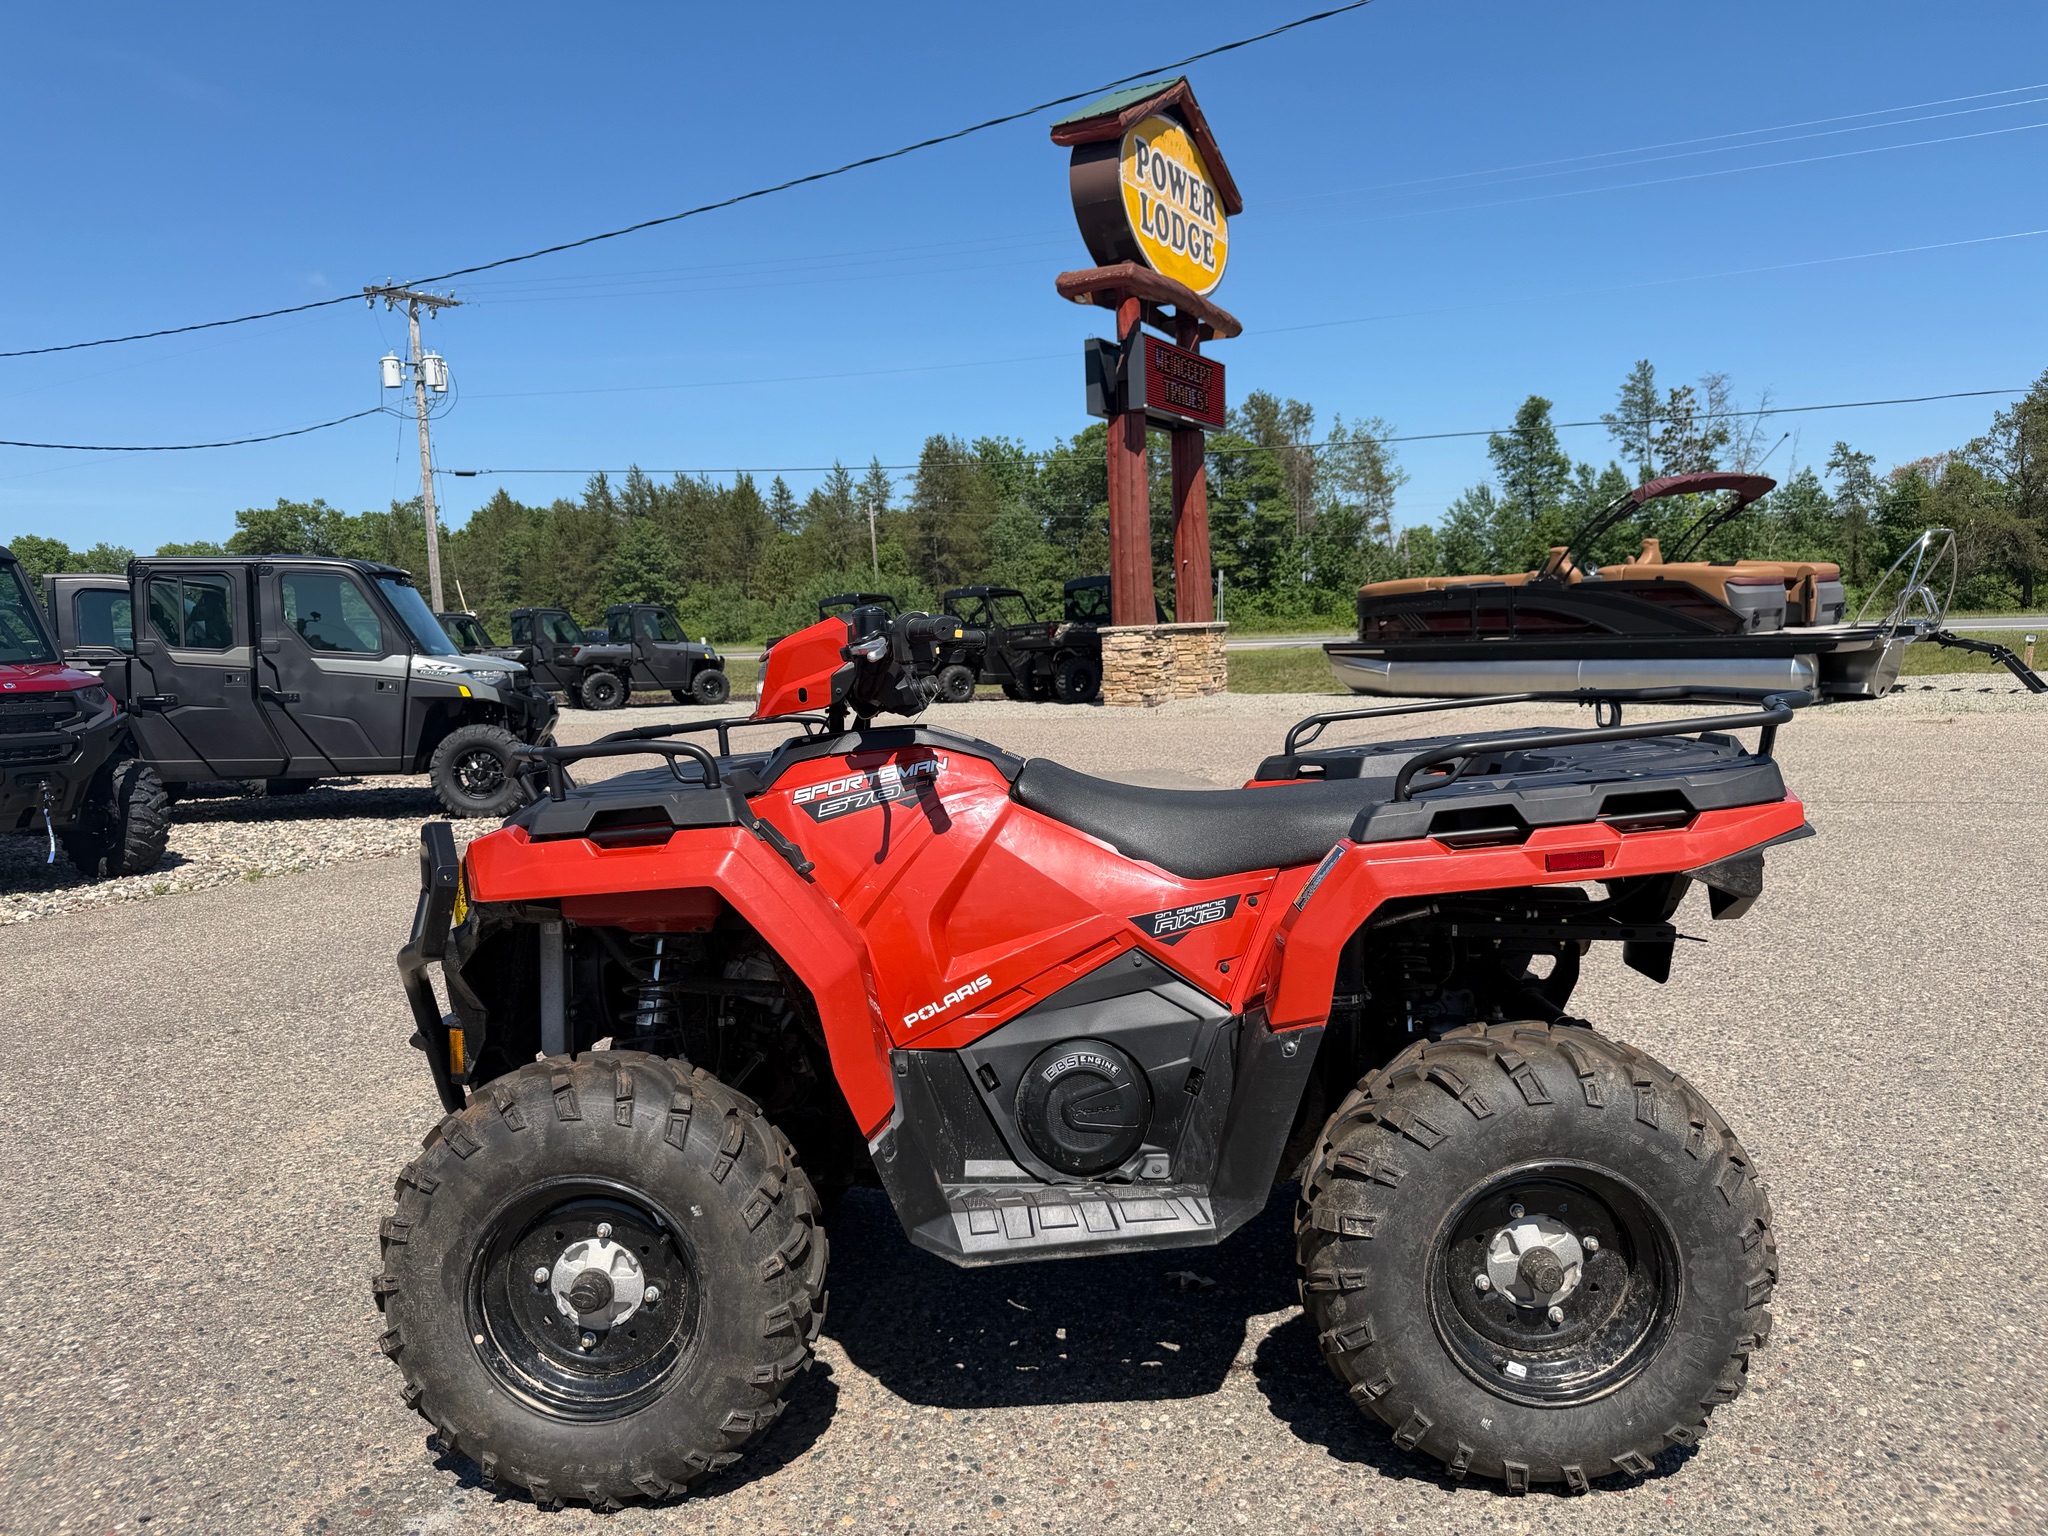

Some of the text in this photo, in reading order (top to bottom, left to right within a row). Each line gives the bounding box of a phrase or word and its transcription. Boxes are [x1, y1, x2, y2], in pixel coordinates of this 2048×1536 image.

[1135, 137, 1217, 227] POWER
[1139, 191, 1216, 270] LODGE
[1155, 347, 1213, 390] WE ACCEPT
[792, 757, 949, 805] SPORTSMAN
[817, 784, 902, 818] 570
[1154, 899, 1227, 920] ON DEMAND
[1154, 906, 1226, 934] AWD
[903, 973, 993, 1029] POLARIS
[1045, 1056, 1077, 1079] EBS
[1079, 1055, 1119, 1073] ENGINE
